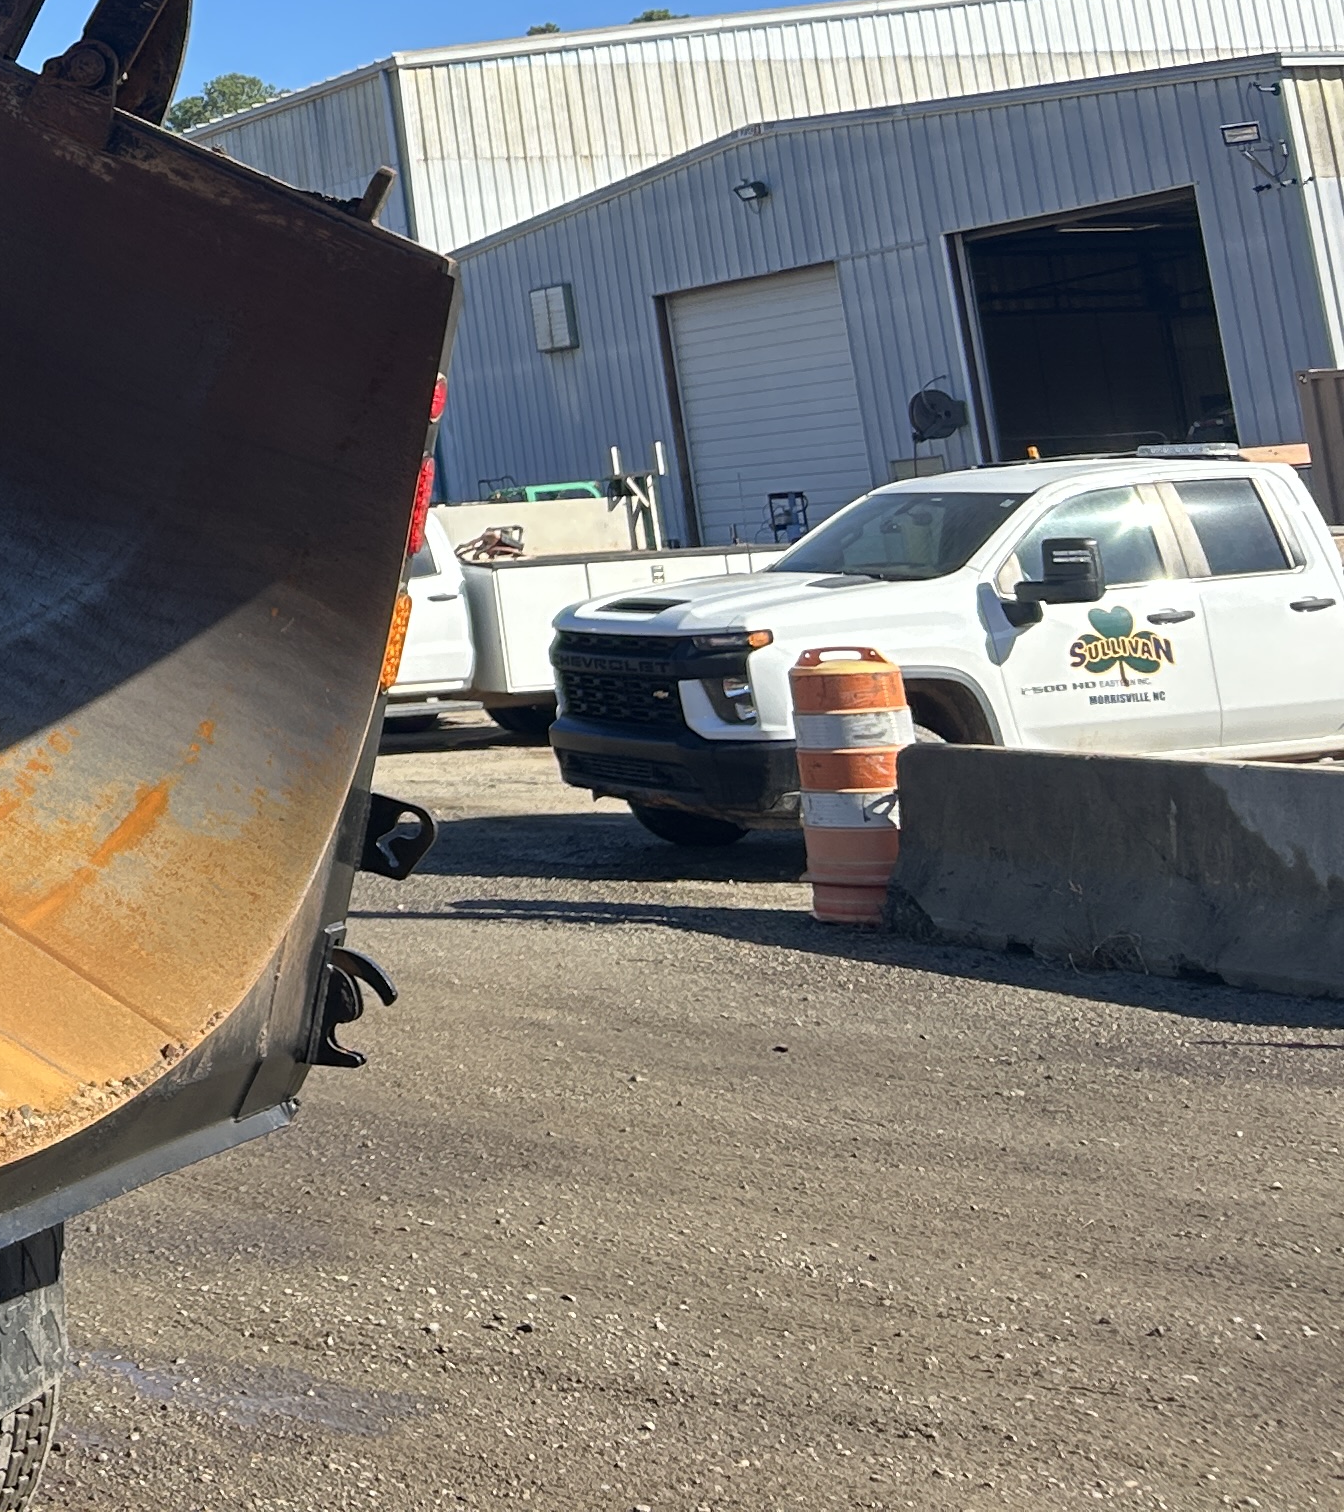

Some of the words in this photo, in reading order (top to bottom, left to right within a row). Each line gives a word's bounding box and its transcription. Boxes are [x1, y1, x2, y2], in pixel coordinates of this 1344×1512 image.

[1069, 636, 1175, 668] SULLIVAN
[1072, 681, 1097, 691] HD
[1089, 692, 1152, 706] MORRISVILLE,
[1152, 691, 1166, 702] NC
